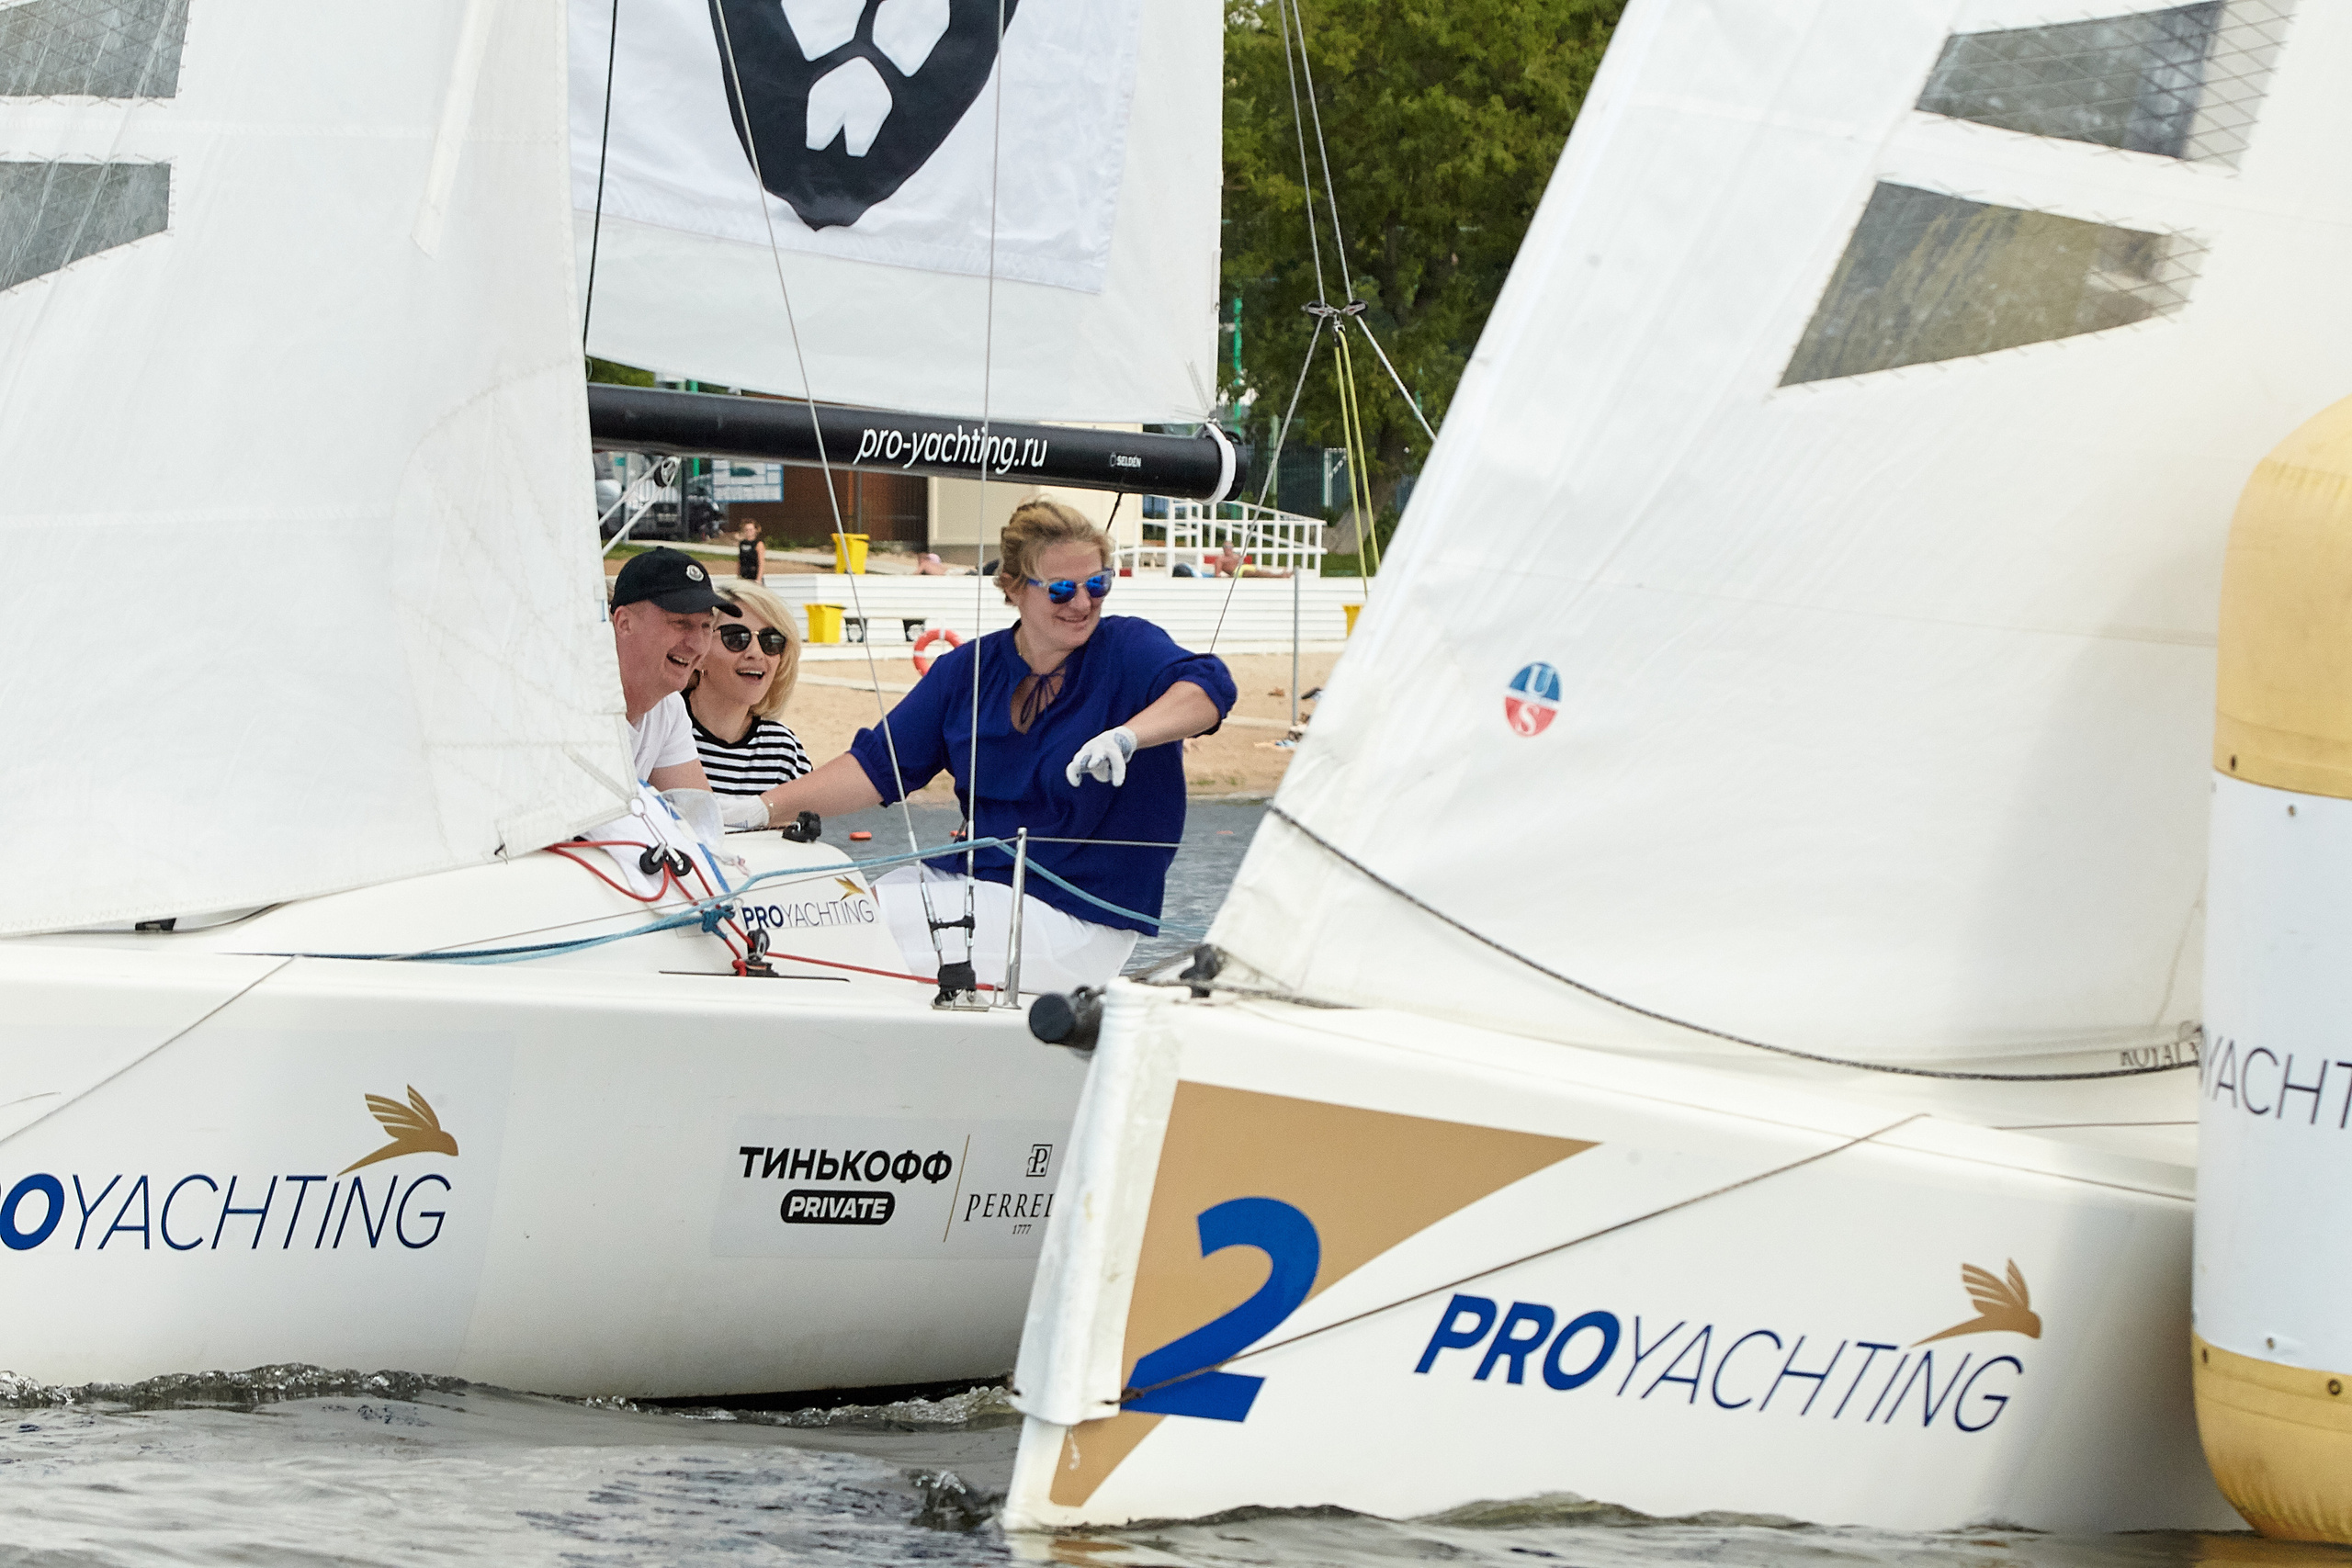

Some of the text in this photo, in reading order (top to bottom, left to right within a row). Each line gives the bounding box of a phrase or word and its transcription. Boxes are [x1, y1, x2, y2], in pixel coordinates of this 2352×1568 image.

[853, 424, 1048, 475] pro-yachting.ru
[742, 898, 875, 931] PROYACHTING
[739, 1146, 953, 1184] ТИНЬКОФФ
[0, 1173, 452, 1251] OYACHTING
[786, 1196, 888, 1220] PRIVATE
[1012, 1224, 1033, 1235] 1777
[1119, 1196, 1322, 1424] 2
[1413, 1292, 2024, 1434] PROYACHTING
